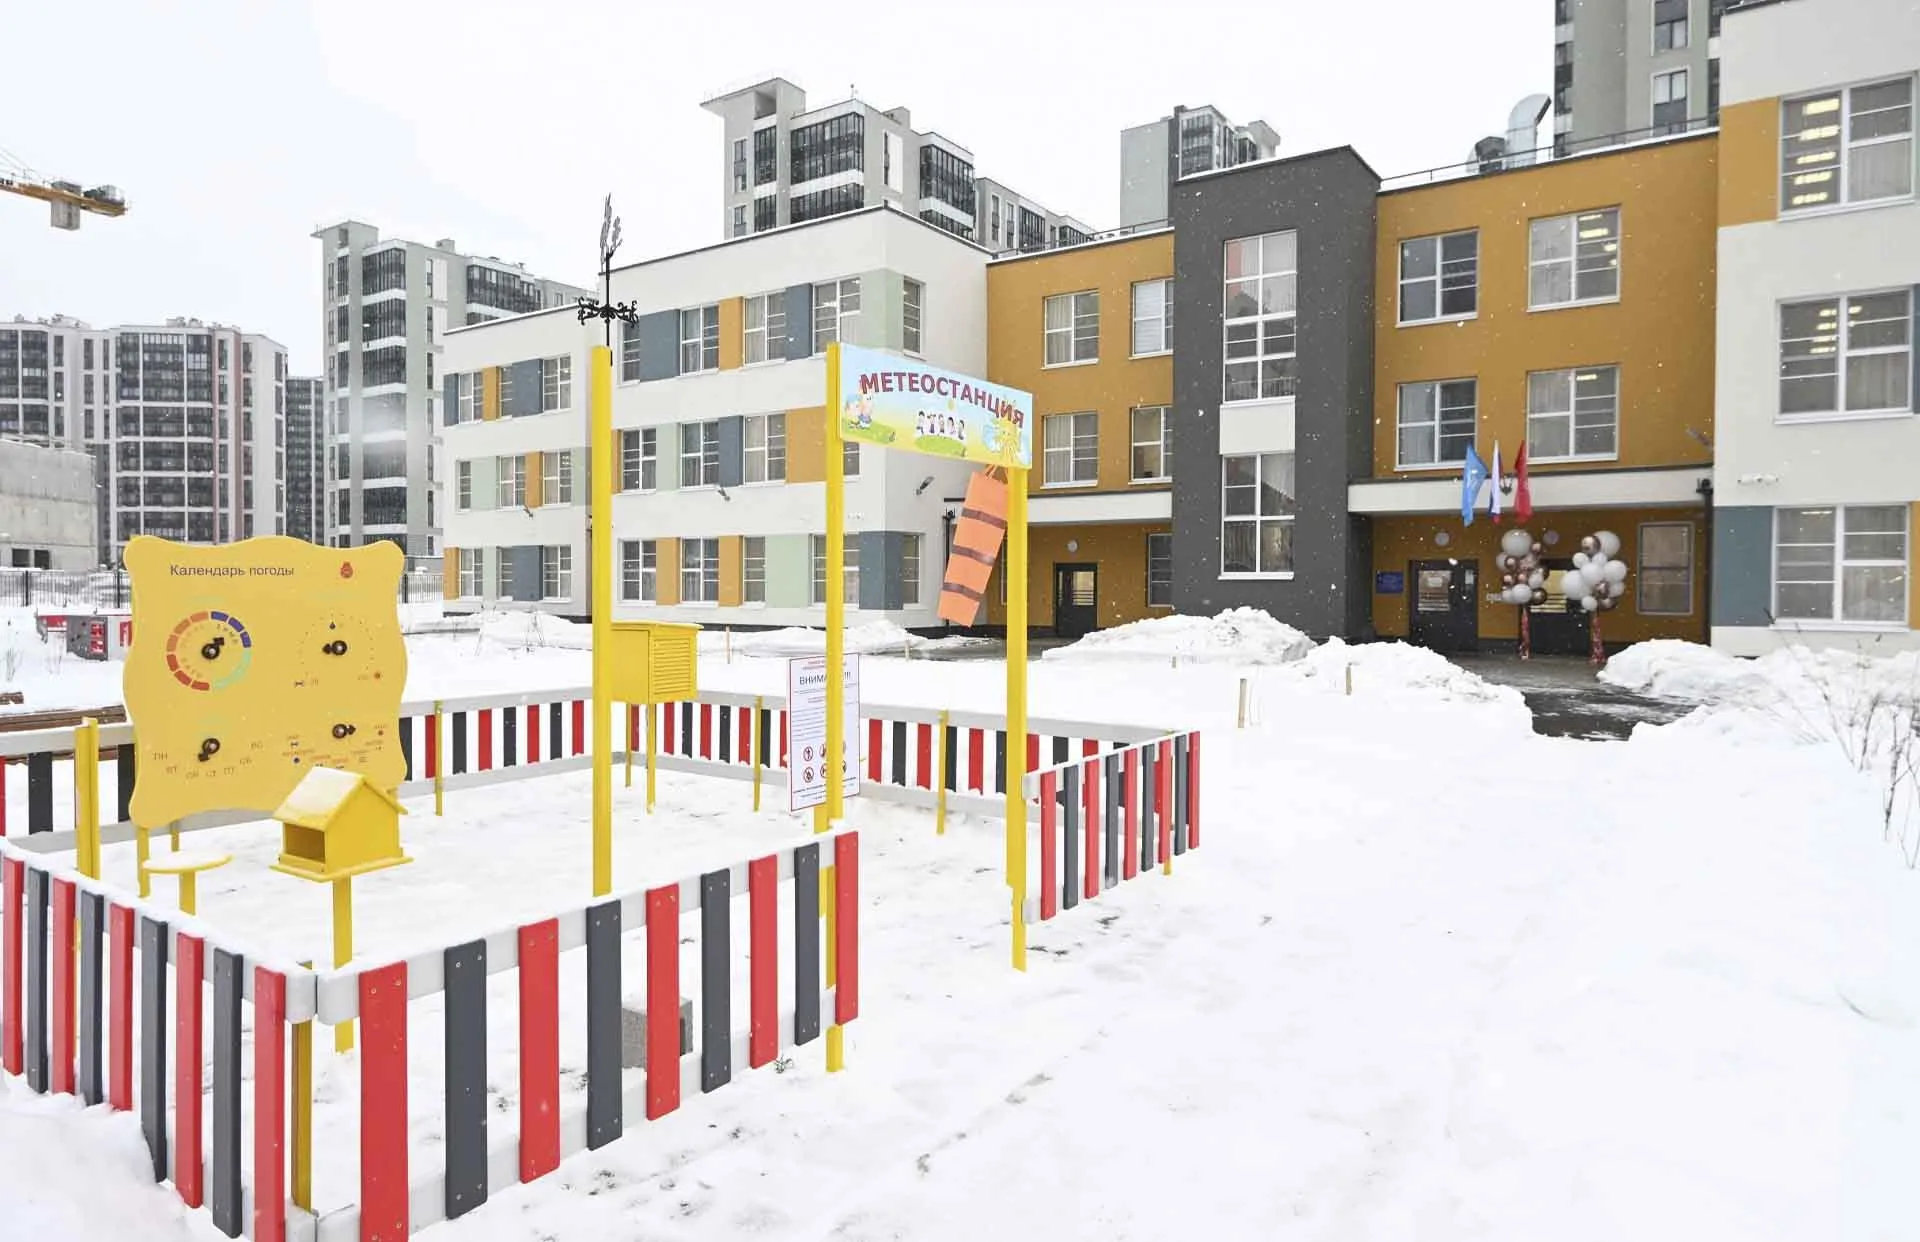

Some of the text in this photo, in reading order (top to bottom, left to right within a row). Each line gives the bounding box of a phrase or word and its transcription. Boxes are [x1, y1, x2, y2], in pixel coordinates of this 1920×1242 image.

[859, 371, 1025, 429] МЕТЕОСТАНЦИЯ
[170, 564, 294, 578] Календарь погоды
